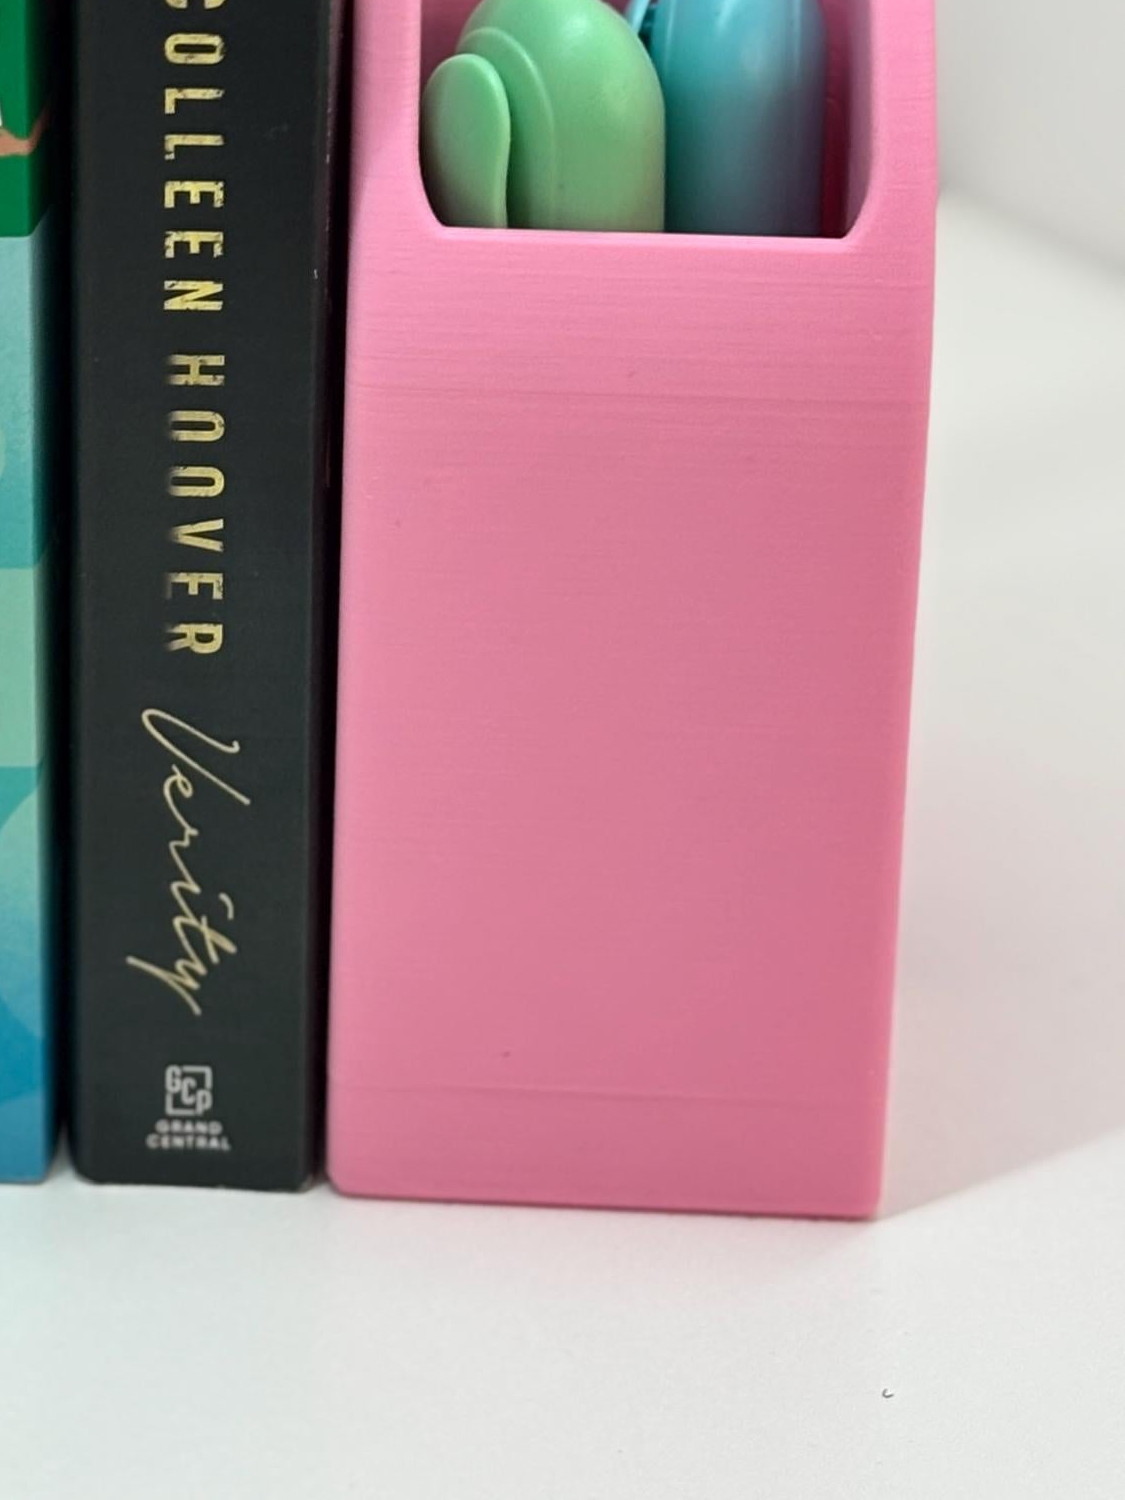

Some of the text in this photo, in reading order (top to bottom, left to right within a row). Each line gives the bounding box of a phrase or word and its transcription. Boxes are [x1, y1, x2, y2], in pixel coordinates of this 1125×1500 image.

[164, 353, 227, 655] HOOVER
[126, 709, 251, 1016] Verity
[145, 1133, 231, 1151] CENTRAL
[155, 1119, 223, 1136] GRAND
